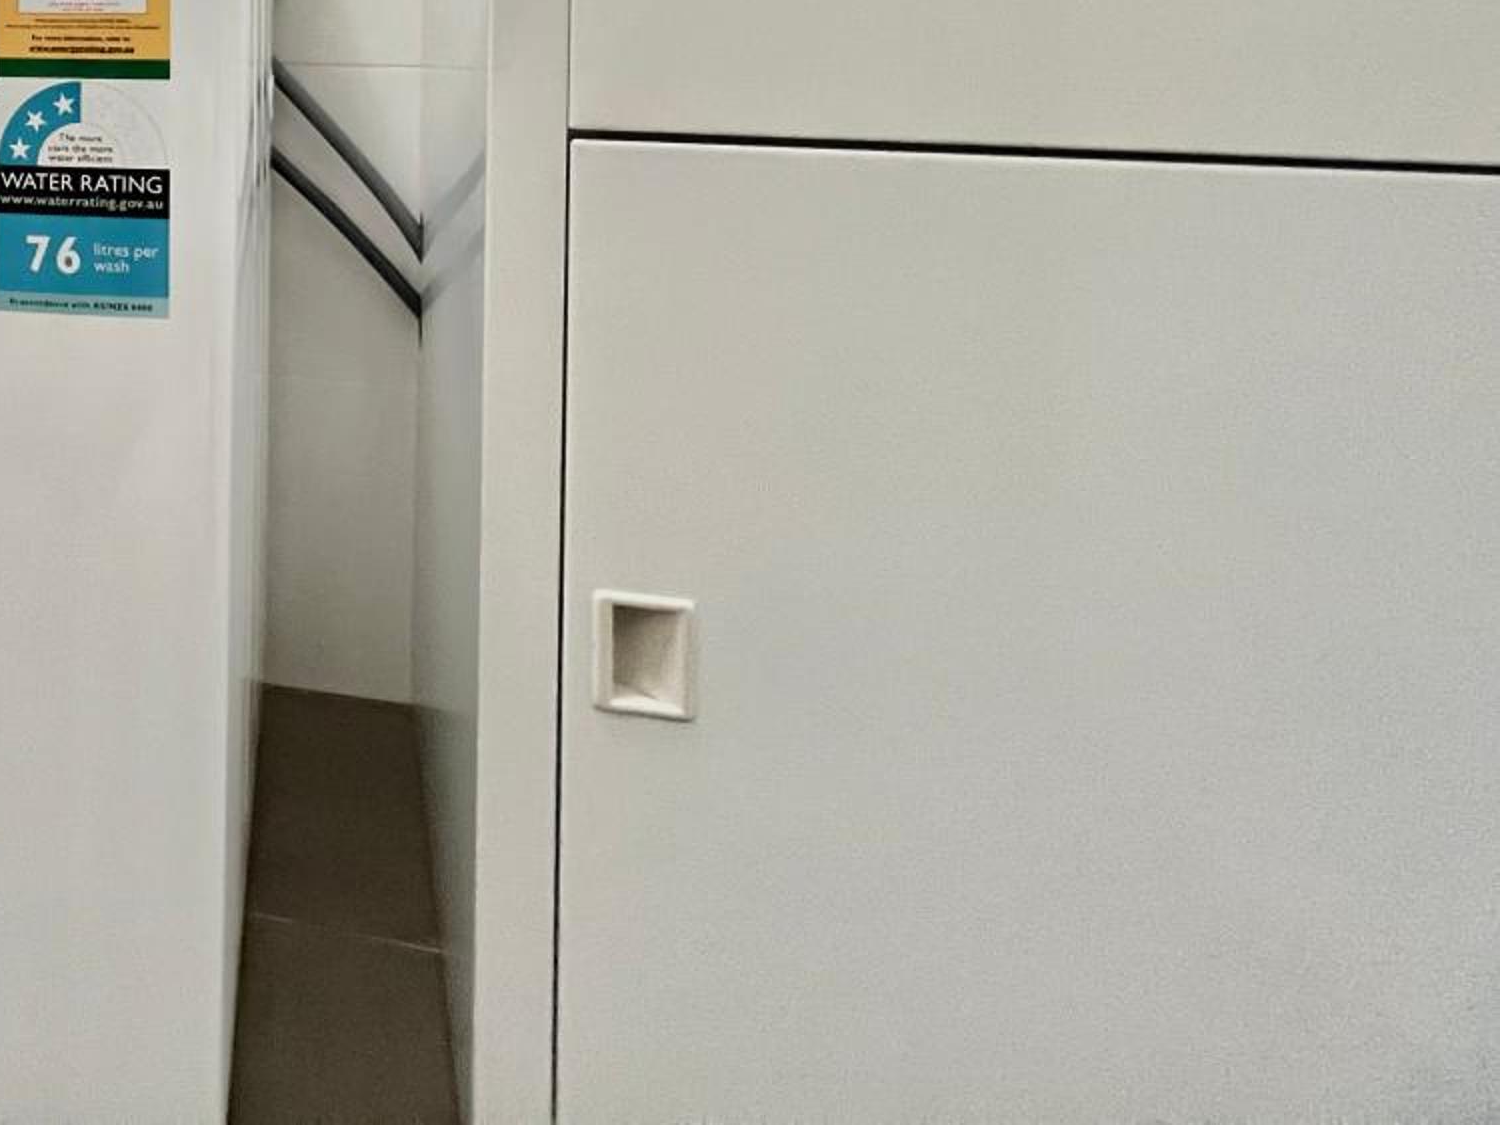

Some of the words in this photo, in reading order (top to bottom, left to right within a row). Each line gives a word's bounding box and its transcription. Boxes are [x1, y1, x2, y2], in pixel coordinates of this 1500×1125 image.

[1, 172, 73, 192] WATER
[80, 174, 164, 195] RATING
[0, 196, 164, 211] www.waterrating.gov.au
[25, 234, 82, 275] 76
[93, 243, 130, 257] litres
[133, 246, 160, 260] per
[93, 259, 130, 273] wash
